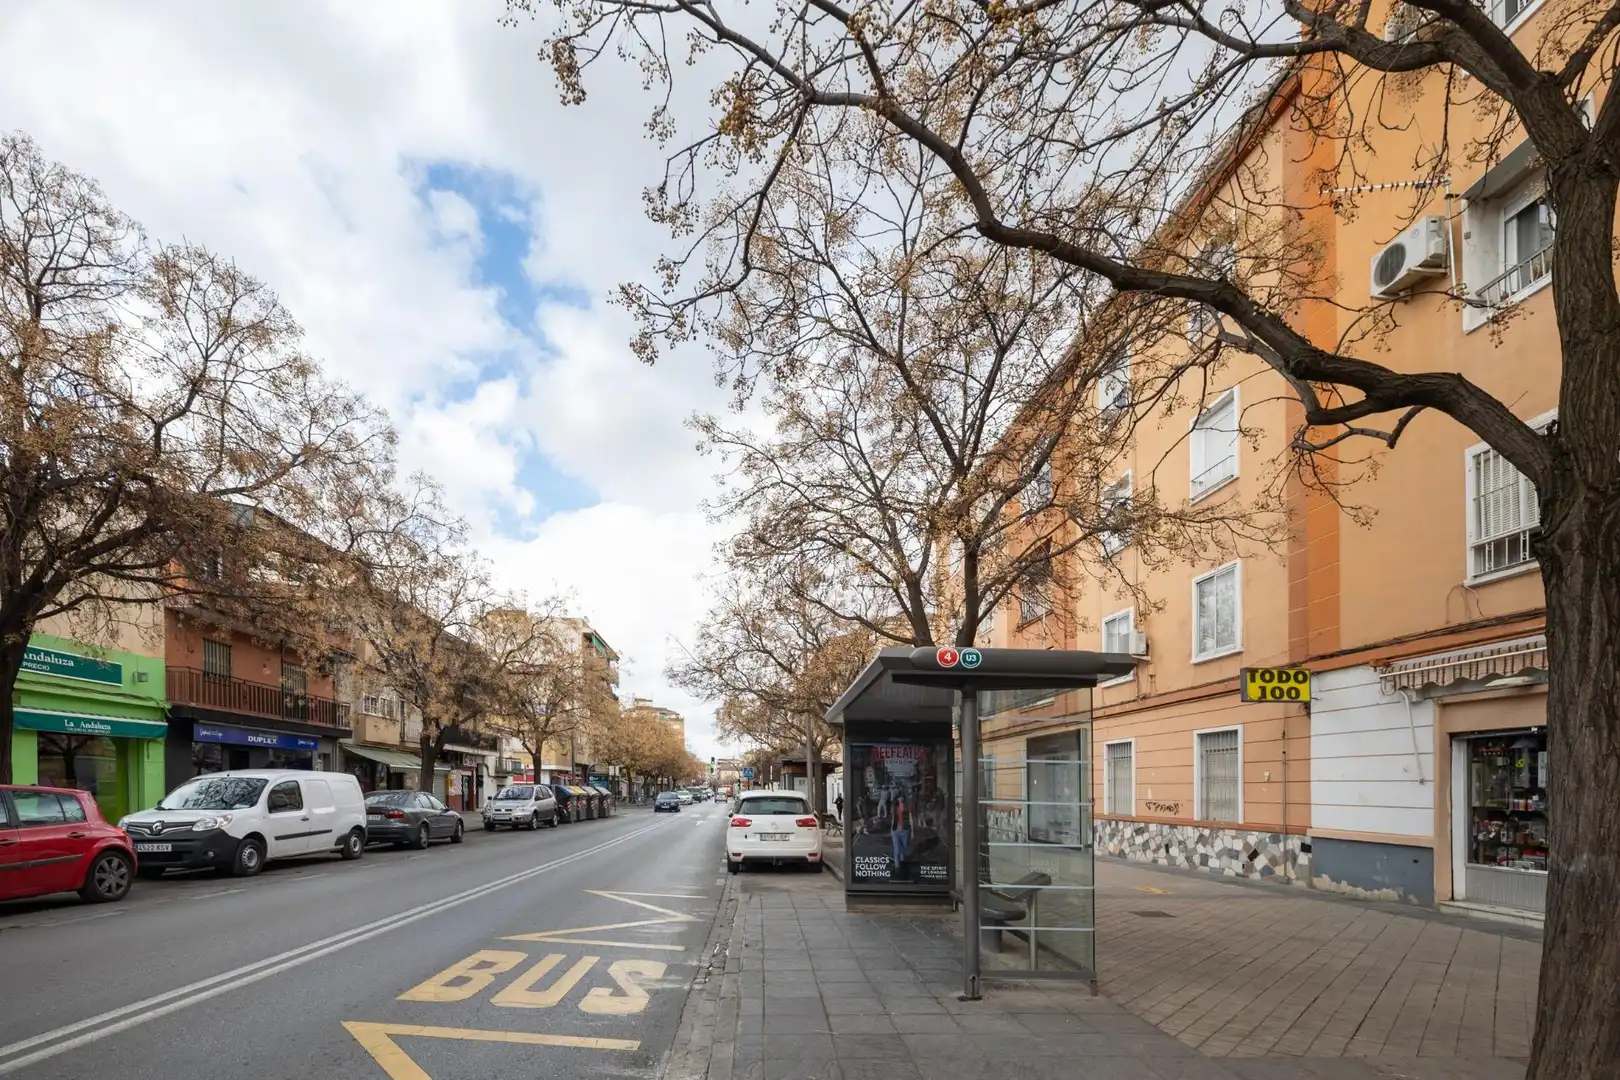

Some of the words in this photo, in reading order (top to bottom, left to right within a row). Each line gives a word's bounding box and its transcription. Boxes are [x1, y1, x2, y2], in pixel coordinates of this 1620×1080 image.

[944, 652, 952, 662] 4
[966, 654, 977, 662] U3
[22, 661, 50, 671] PRECIO
[1247, 669, 1308, 684] TODO
[1258, 685, 1301, 700] 100
[64, 719, 75, 727] La
[80, 720, 112, 731] Andaluza
[247, 735, 278, 745] DUPLEX
[855, 856, 890, 864] CLASSICS
[396, 950, 668, 1015] BUS
